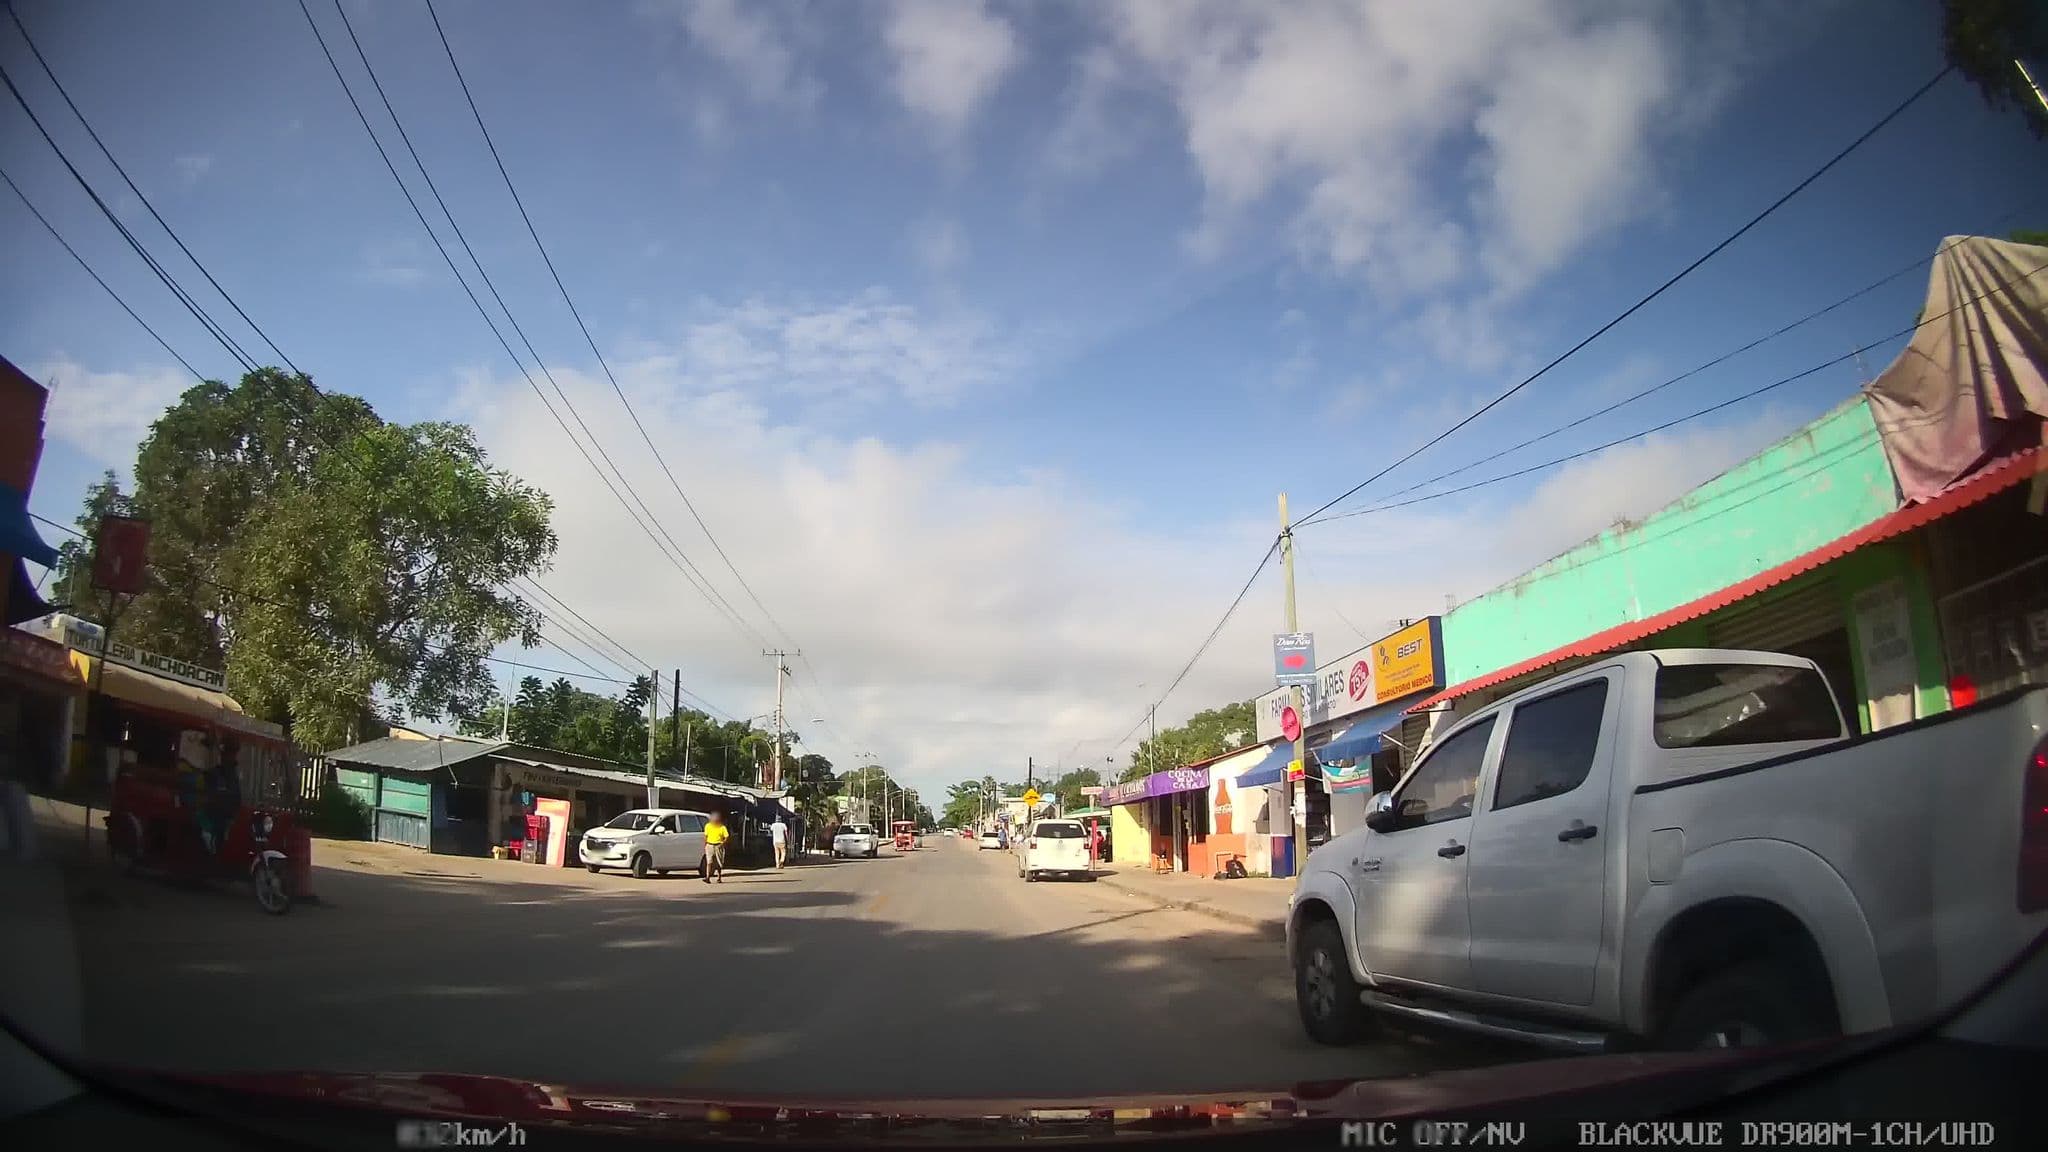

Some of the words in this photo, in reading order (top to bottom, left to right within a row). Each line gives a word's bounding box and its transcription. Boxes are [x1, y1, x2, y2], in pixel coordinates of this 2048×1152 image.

[1397, 639, 1422, 659] BEST
[141, 651, 225, 687] MICHOACAN
[1377, 682, 1411, 700] CONSULTORIO
[1412, 674, 1433, 689] MEDICO
[1168, 769, 1202, 779] COCINA
